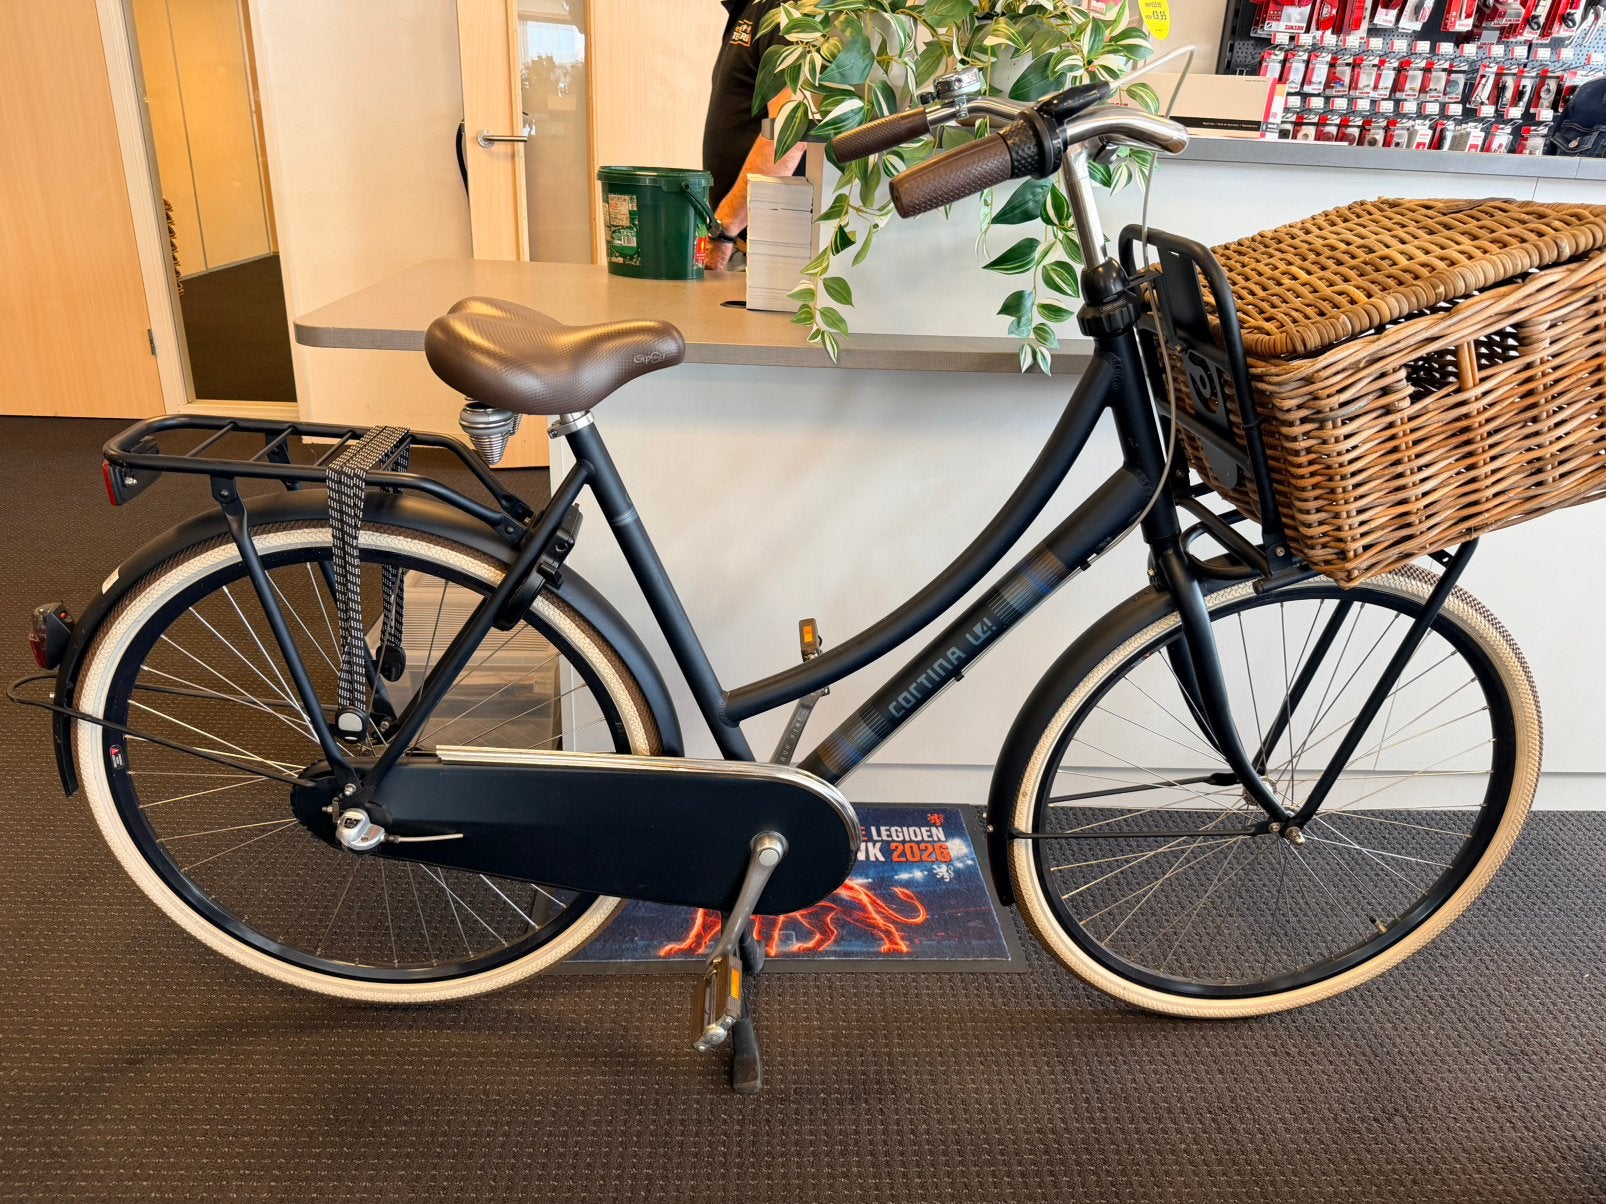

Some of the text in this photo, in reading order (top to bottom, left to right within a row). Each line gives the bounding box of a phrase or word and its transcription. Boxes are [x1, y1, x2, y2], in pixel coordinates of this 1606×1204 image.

[888, 646, 967, 718] CORTINA
[870, 826, 946, 841] LEGIOEN
[890, 842, 952, 862] 2026
